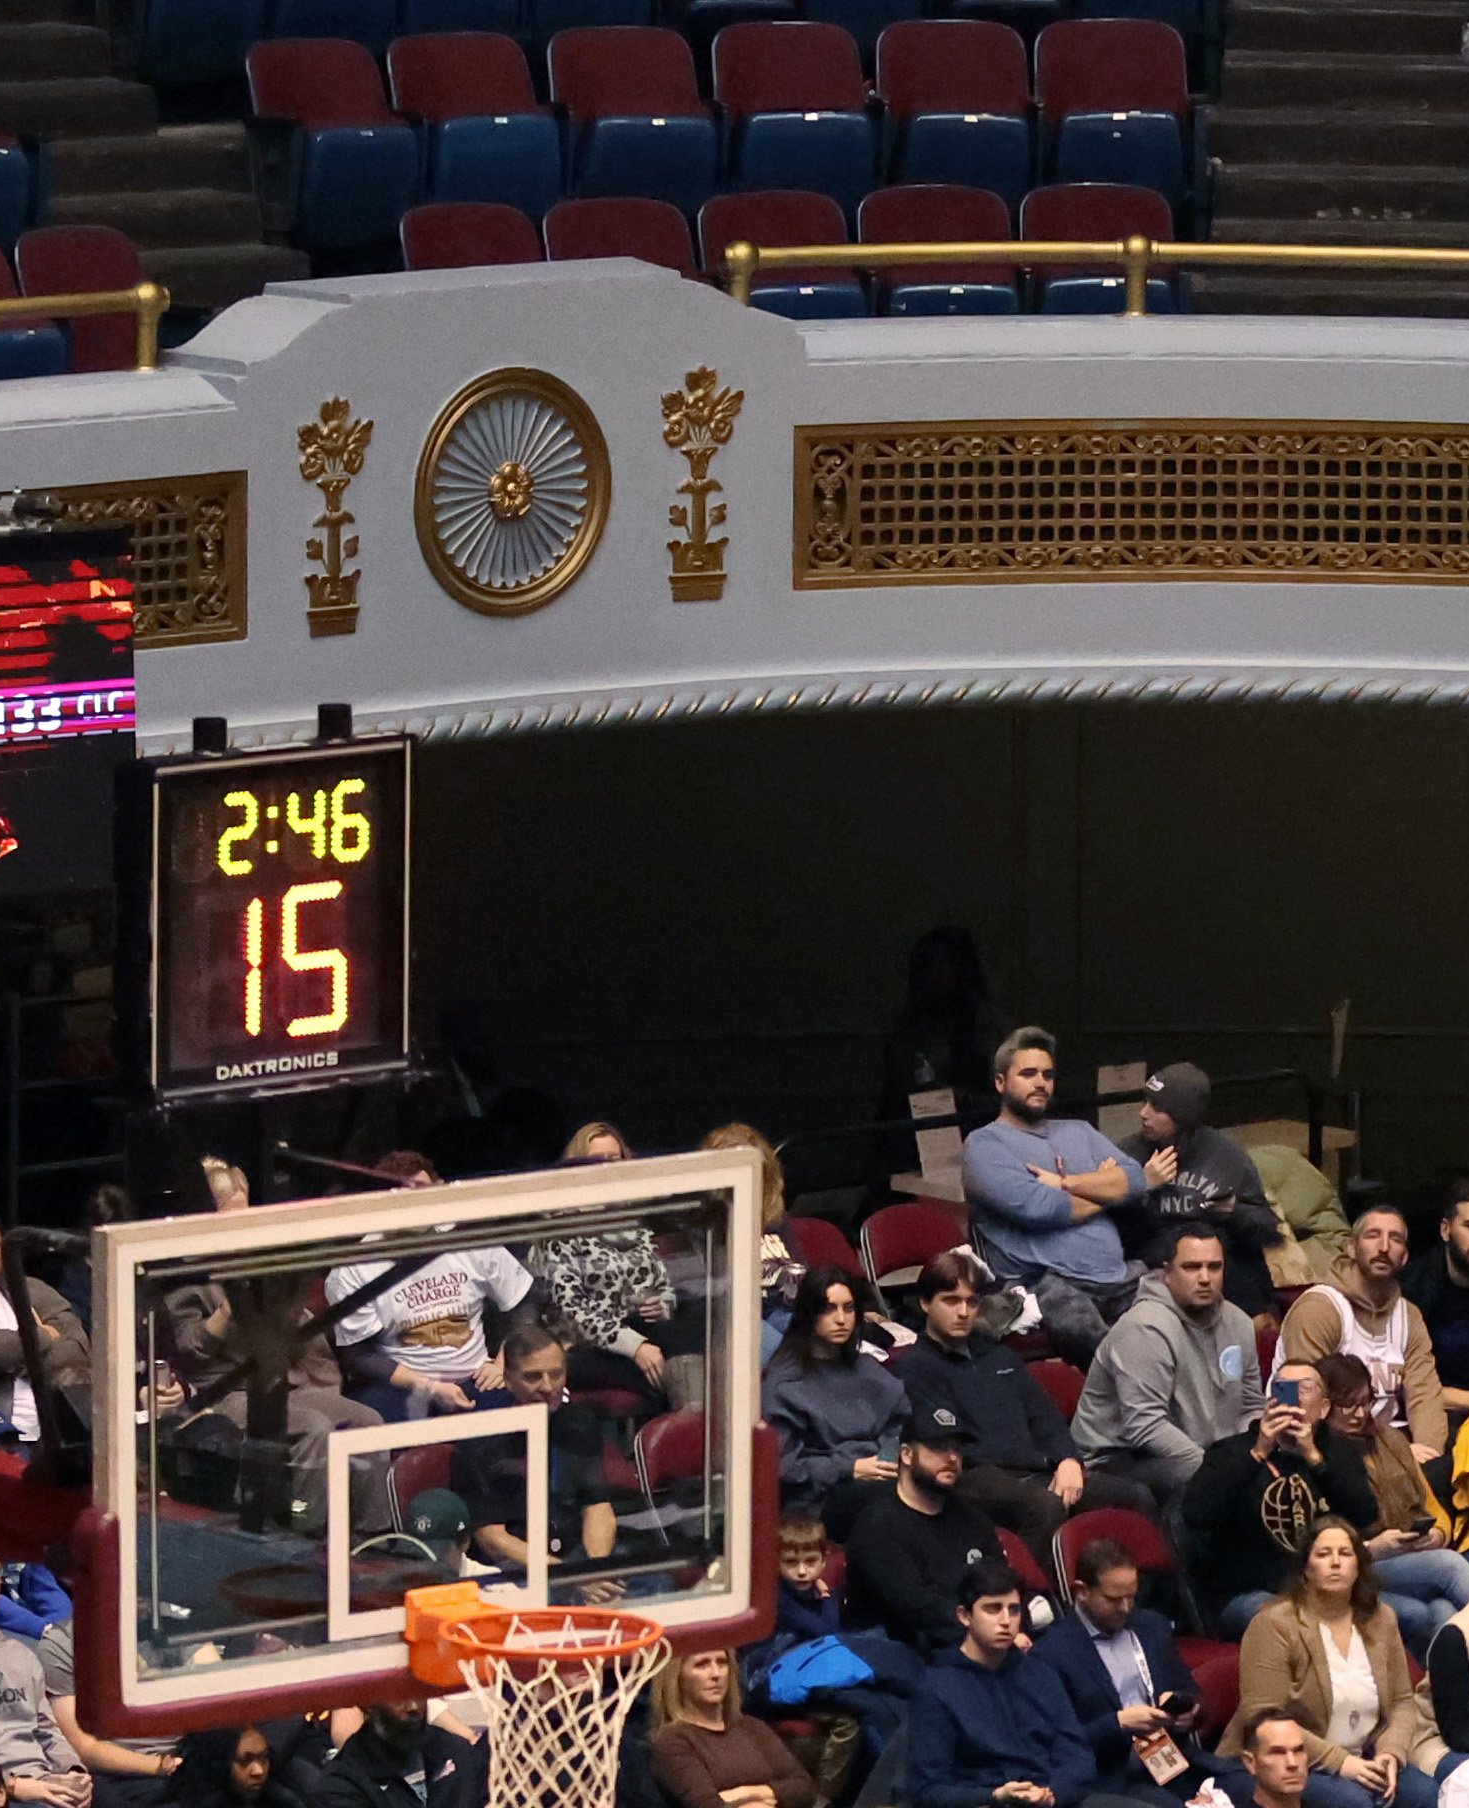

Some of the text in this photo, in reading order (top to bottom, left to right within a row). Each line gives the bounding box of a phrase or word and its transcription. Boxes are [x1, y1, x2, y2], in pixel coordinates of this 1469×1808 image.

[217, 777, 371, 876] 2:46
[244, 879, 349, 1038] 15
[216, 1051, 339, 1081] DAKTRONICS
[1160, 1195, 1194, 1213] NYC
[393, 1271, 469, 1304] CLEVELAND
[406, 1284, 462, 1310] CHARGE
